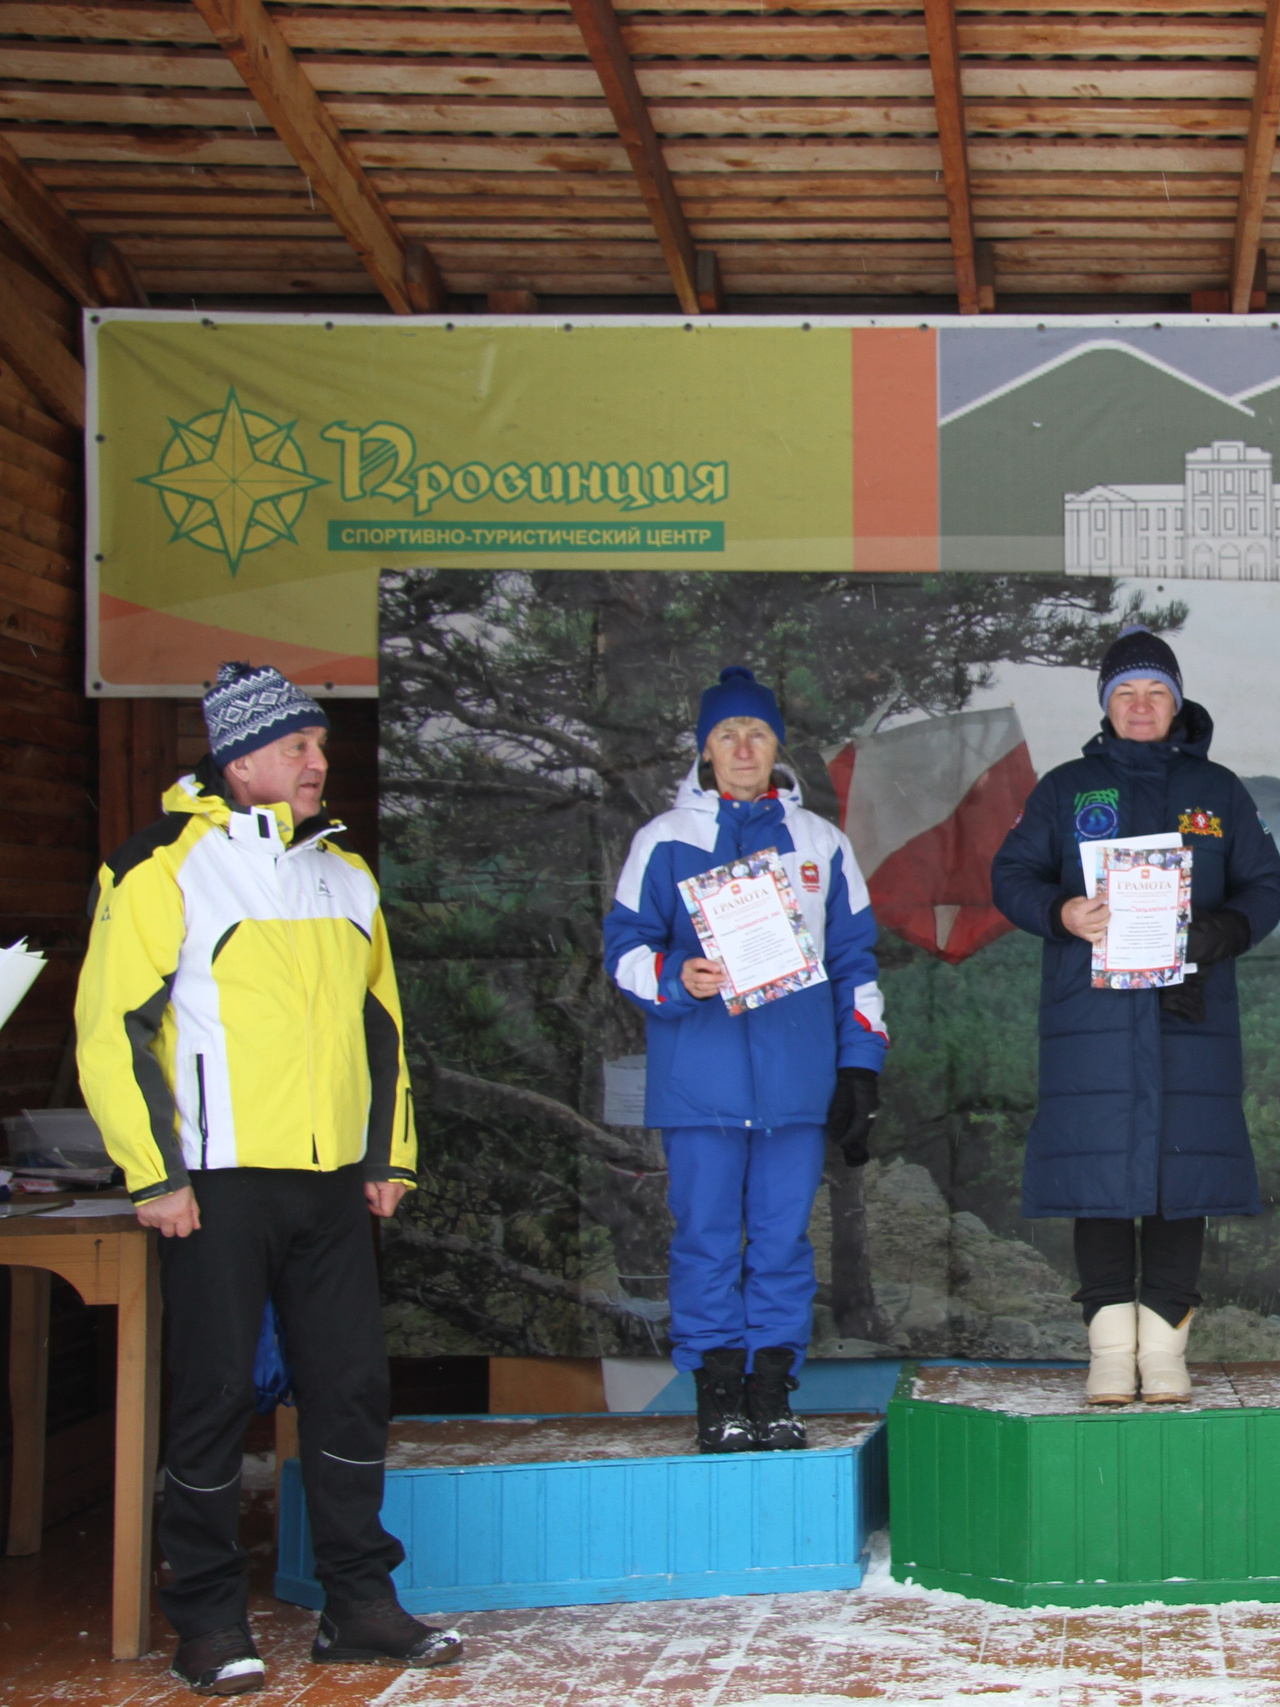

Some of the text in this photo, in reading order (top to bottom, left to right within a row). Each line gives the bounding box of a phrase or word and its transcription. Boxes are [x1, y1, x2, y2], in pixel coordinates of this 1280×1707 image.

[320, 420, 728, 516] Провинция
[341, 526, 712, 547] СПОРТИВНО-ТУРИСТИЧЕСКИЙ ЦЕНТР
[1117, 881, 1172, 890] ГРАМОТА
